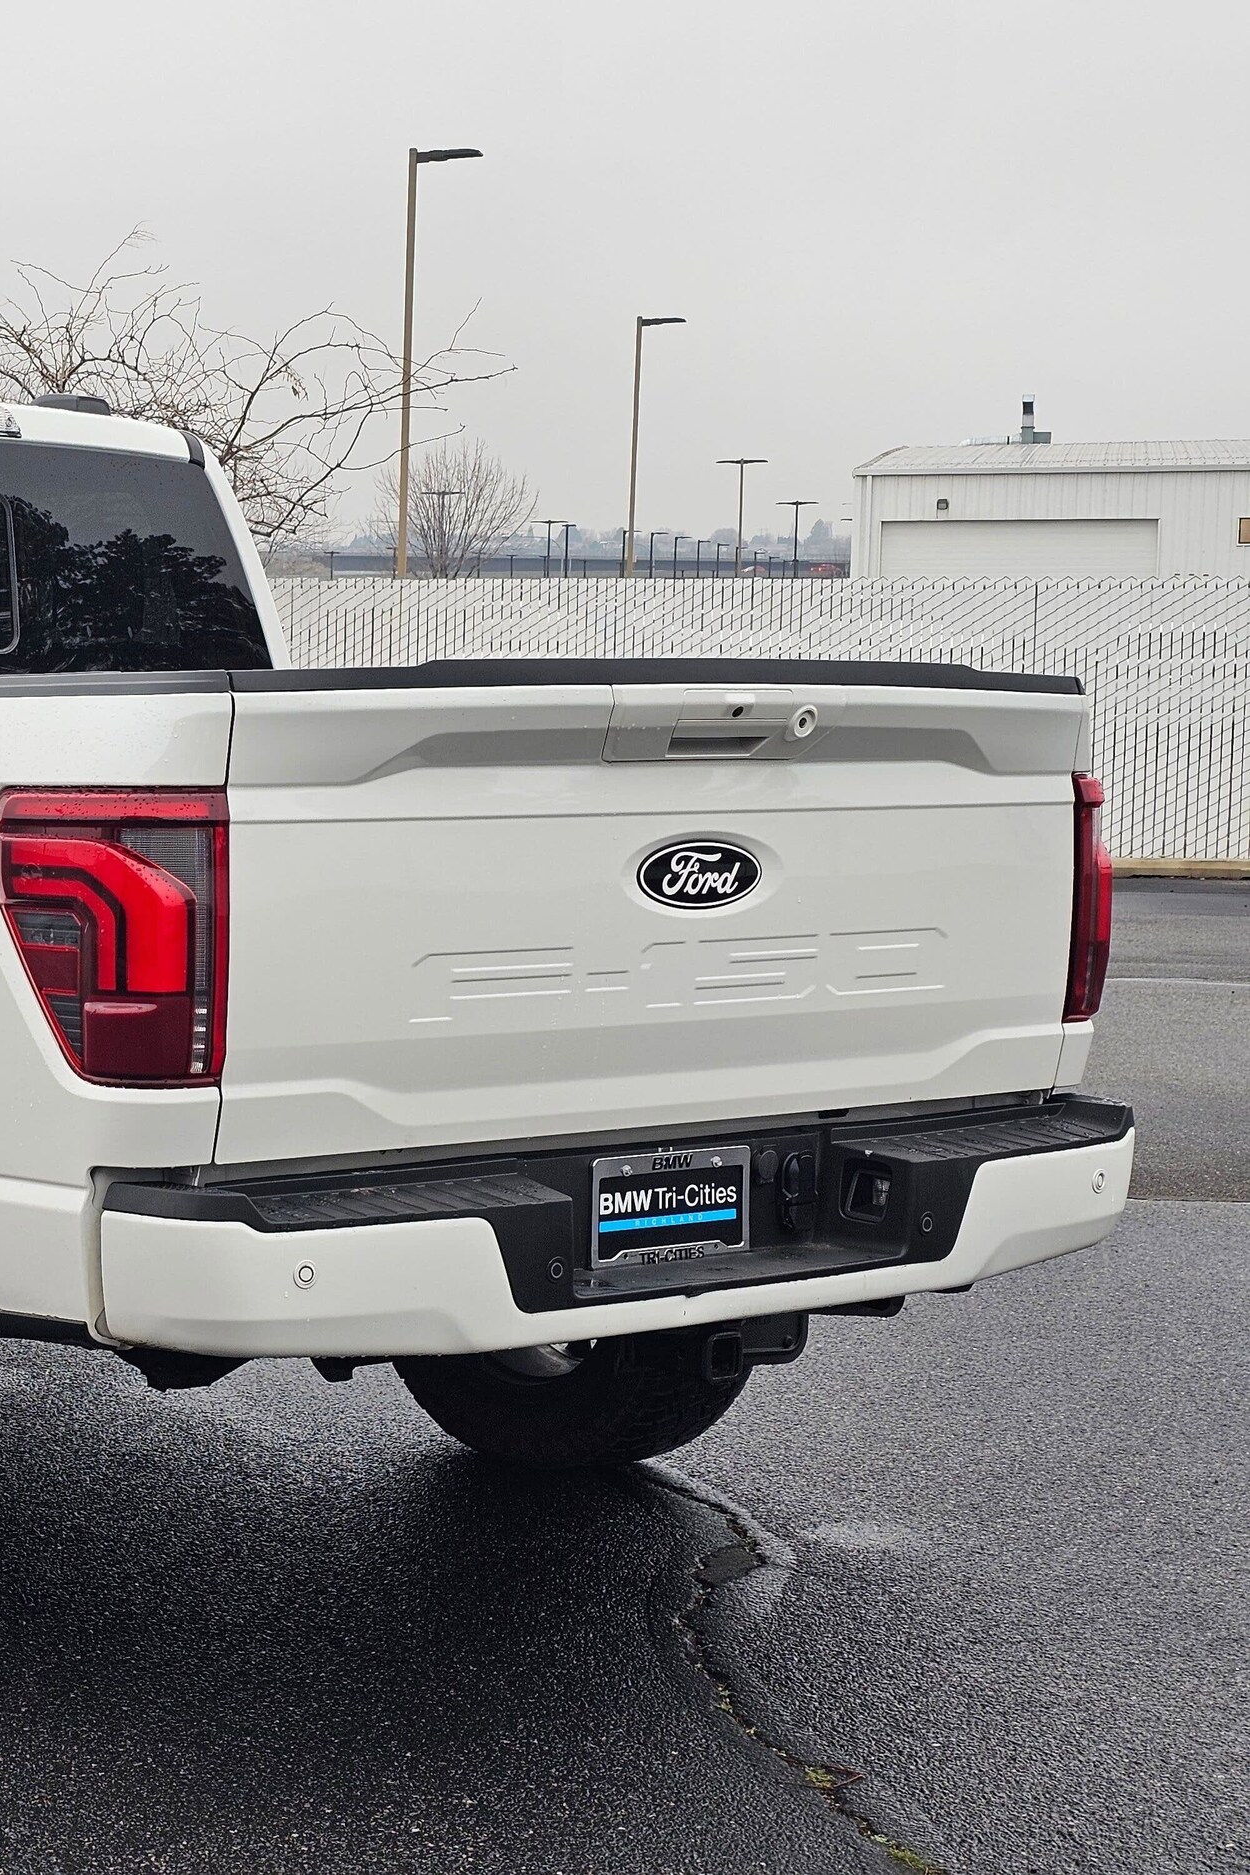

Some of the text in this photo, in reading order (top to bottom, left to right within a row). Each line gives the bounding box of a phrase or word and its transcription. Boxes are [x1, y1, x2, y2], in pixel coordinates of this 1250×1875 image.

[662, 852, 740, 895] Ford
[652, 1154, 693, 1171] BMW
[599, 1183, 737, 1215] BMW Tri-Cities
[634, 1213, 703, 1227] RICHLAND
[639, 1246, 705, 1266] TRI-CITIES
